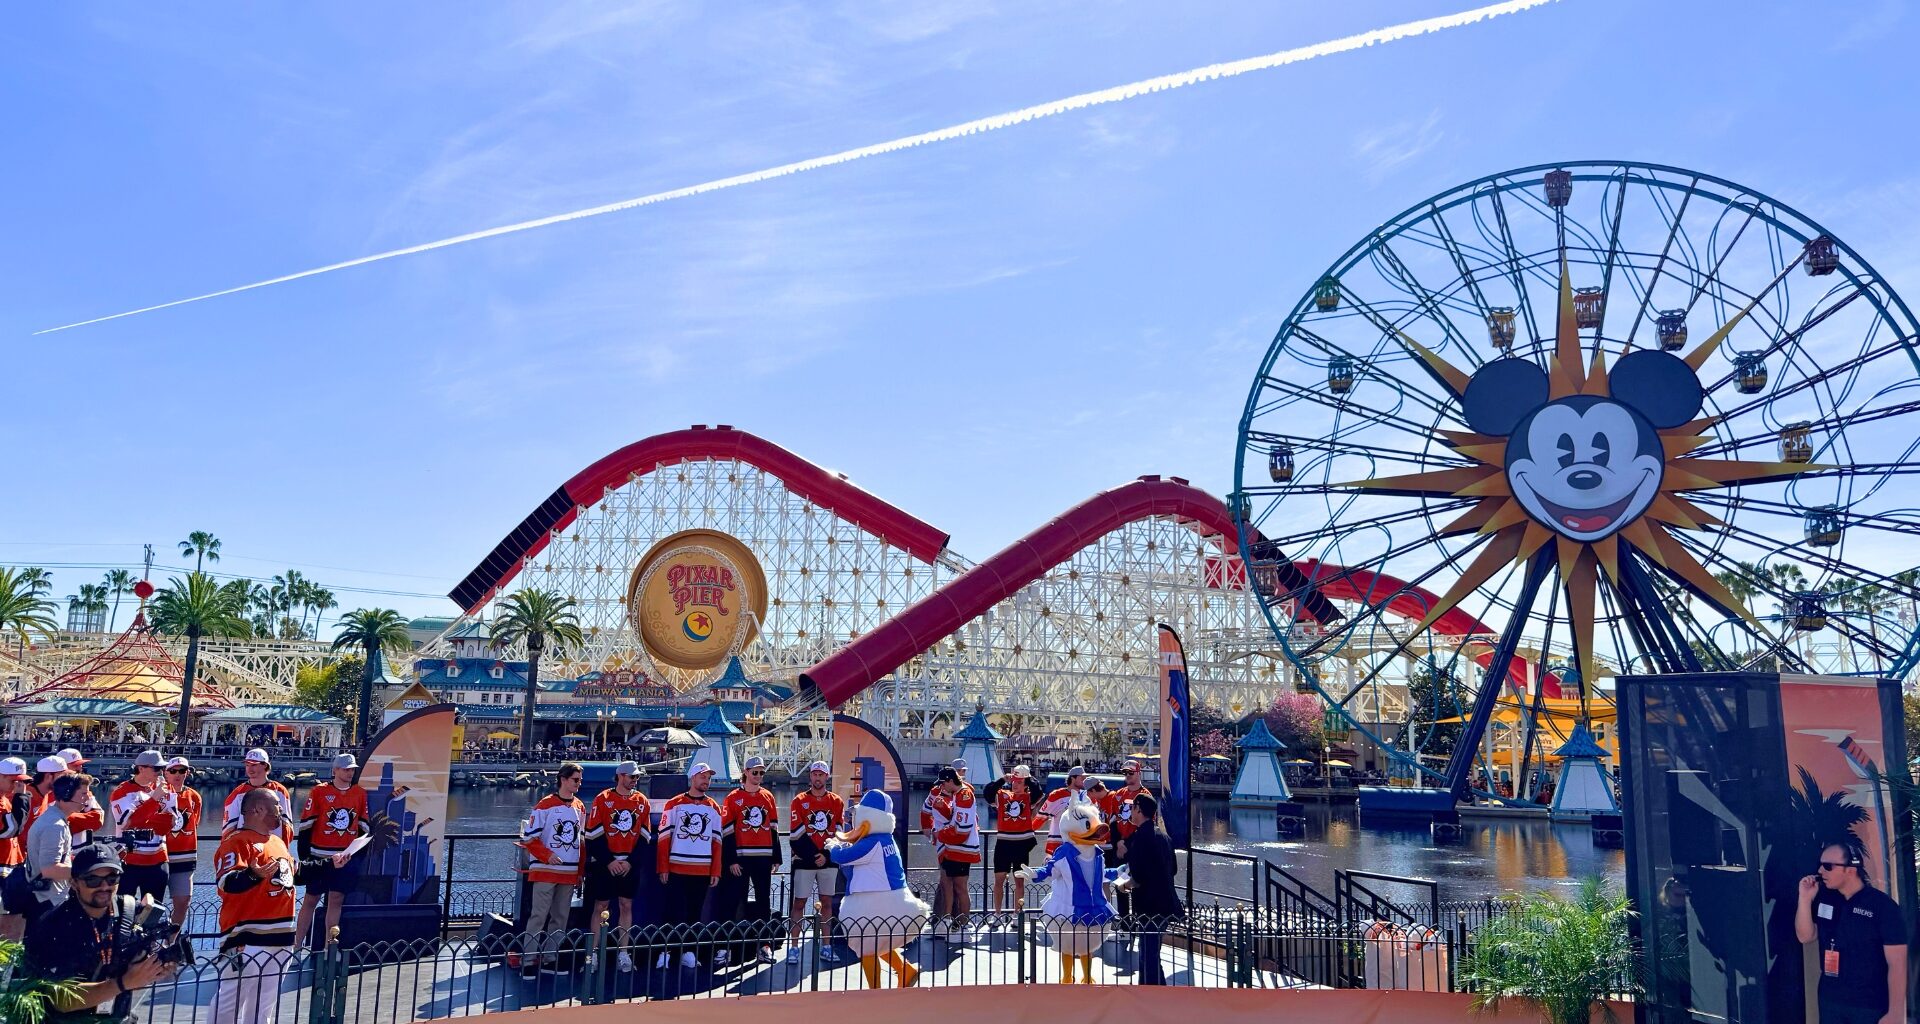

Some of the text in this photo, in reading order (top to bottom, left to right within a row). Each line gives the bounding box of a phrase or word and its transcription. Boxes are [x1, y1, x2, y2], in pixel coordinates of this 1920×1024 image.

[667, 564, 735, 593] PIXAR
[673, 586, 729, 615] PIER
[580, 688, 624, 696] MIDWAY
[1852, 906, 1874, 918] DUCKS
